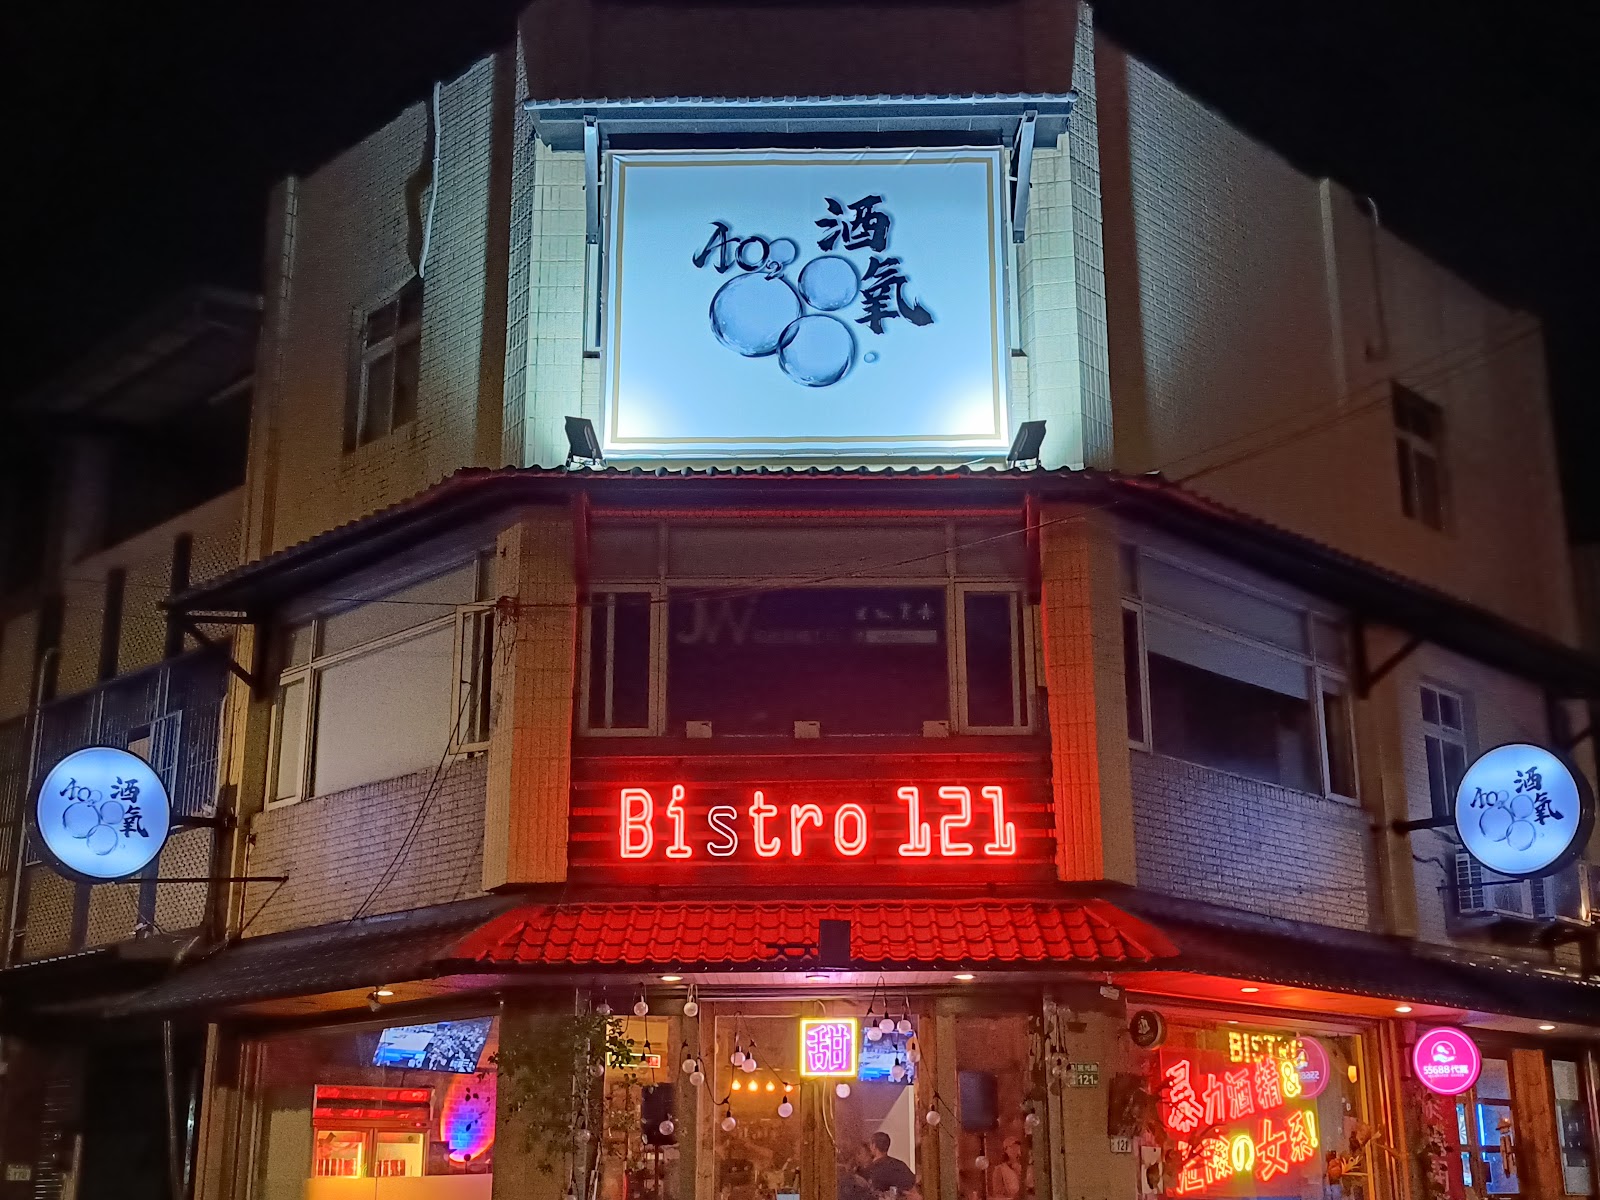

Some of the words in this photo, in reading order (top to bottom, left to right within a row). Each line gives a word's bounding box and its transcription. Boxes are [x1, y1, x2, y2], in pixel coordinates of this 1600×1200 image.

[620, 785, 867, 858] Bistro
[898, 786, 1016, 856] 121
[807, 1024, 850, 1071] 甜
